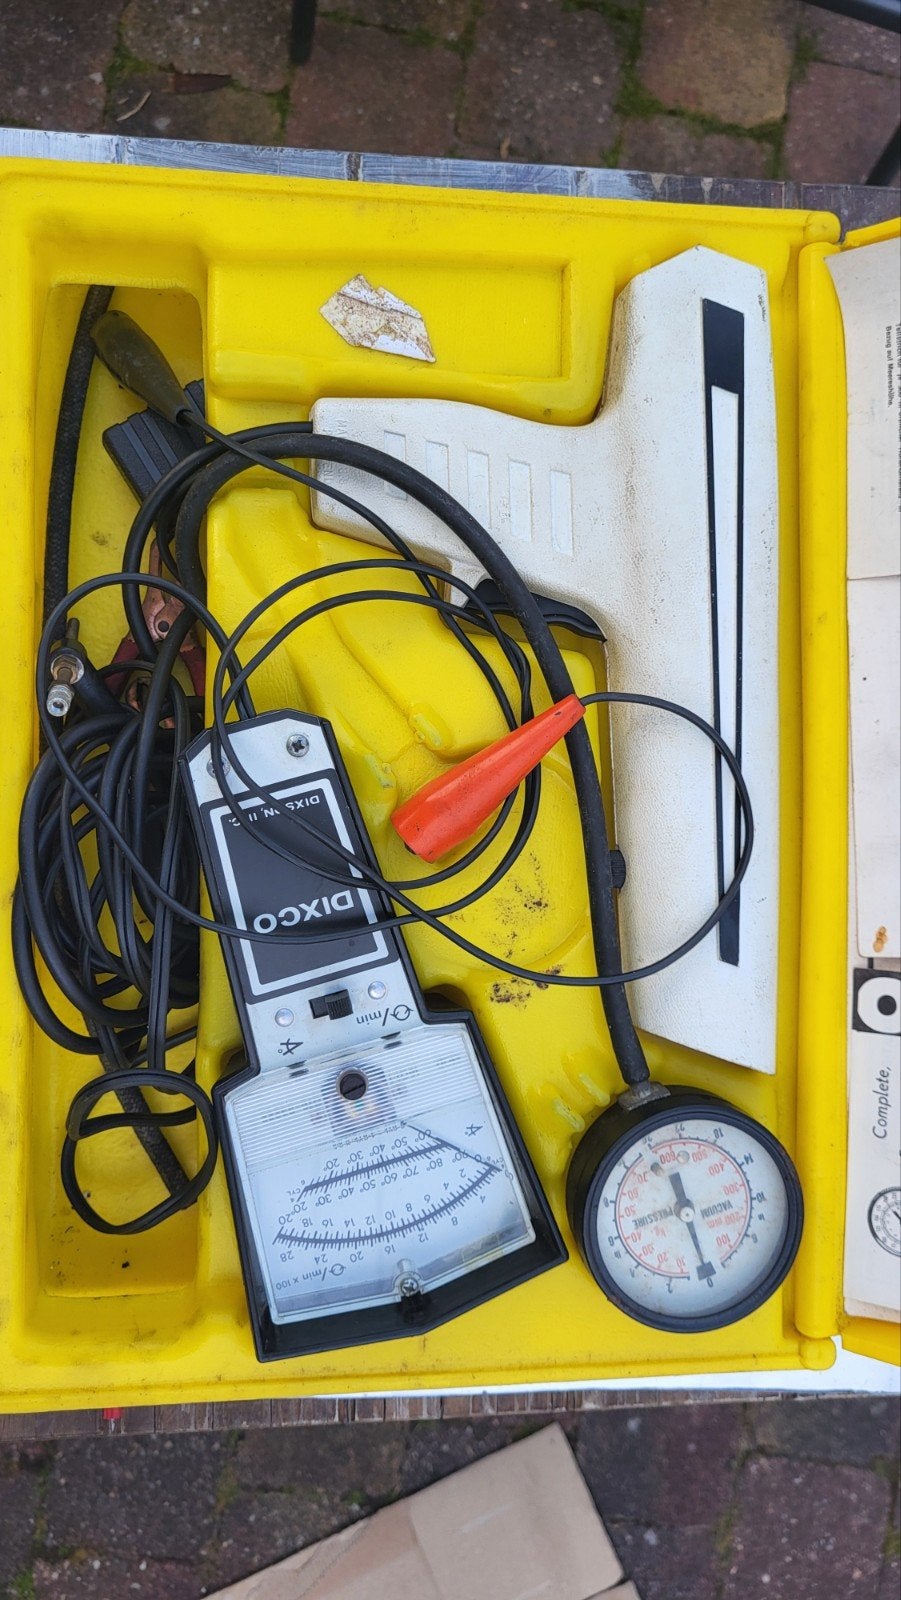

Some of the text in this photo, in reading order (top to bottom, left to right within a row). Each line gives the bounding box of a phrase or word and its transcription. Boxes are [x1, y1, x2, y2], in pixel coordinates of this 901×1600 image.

[885, 325, 893, 348] Bezug
[261, 795, 320, 817] DIXSN,
[253, 890, 354, 933] DIXCO
[872, 1067, 891, 1139] Complete,
[714, 1127, 723, 1140] 18
[659, 1151, 676, 1164] 600
[744, 1153, 754, 1166] 14
[459, 1168, 466, 1178] 2
[708, 1162, 725, 1176] 400
[443, 1182, 449, 1190] 4
[723, 1182, 740, 1195] 300
[424, 1195, 430, 1203] 6
[480, 1196, 485, 1204] 4
[756, 1191, 766, 1203] 10
[406, 1203, 412, 1212] 8
[700, 1199, 733, 1220] VACUUM
[279, 1213, 293, 1225] 20
[365, 1214, 376, 1225] 12
[385, 1209, 395, 1220] 10
[632, 1206, 673, 1230] PRESSURE
[725, 1211, 741, 1225] 200
[302, 1218, 313, 1227] 18
[322, 1218, 333, 1227] 16
[344, 1218, 355, 1228] 14
[451, 1217, 458, 1226] 8
[418, 1232, 428, 1243] 12
[608, 1235, 614, 1246] 6
[716, 1233, 731, 1247] 100
[384, 1245, 395, 1254] 16
[280, 1250, 294, 1262] 28
[314, 1254, 328, 1264] 24
[350, 1251, 364, 1262] 20
[276, 1279, 291, 1290] 100
[706, 1277, 714, 1288] 0
